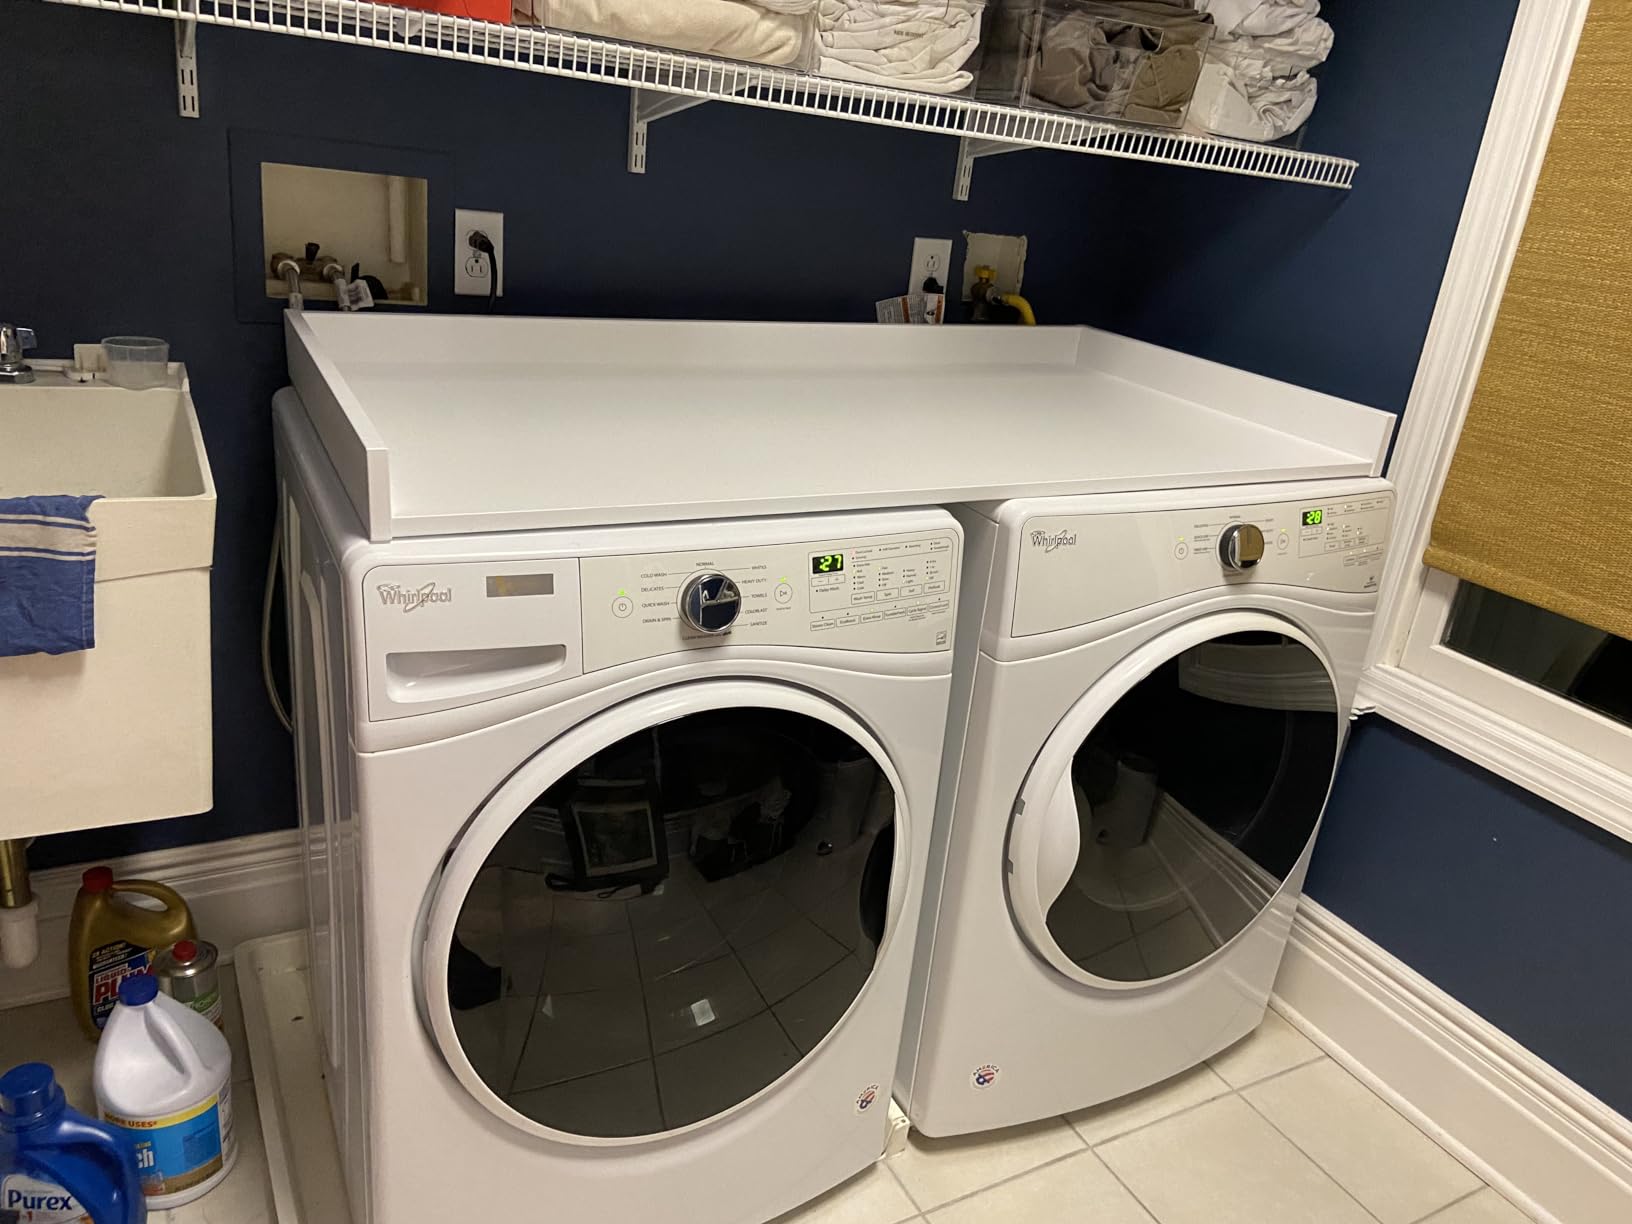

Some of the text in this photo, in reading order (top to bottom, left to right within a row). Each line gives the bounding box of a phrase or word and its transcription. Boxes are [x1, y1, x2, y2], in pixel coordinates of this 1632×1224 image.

[1031, 529, 1077, 553] Whirlpool
[376, 582, 452, 613] Whirlpool
[8, 1189, 73, 1211] Purex
